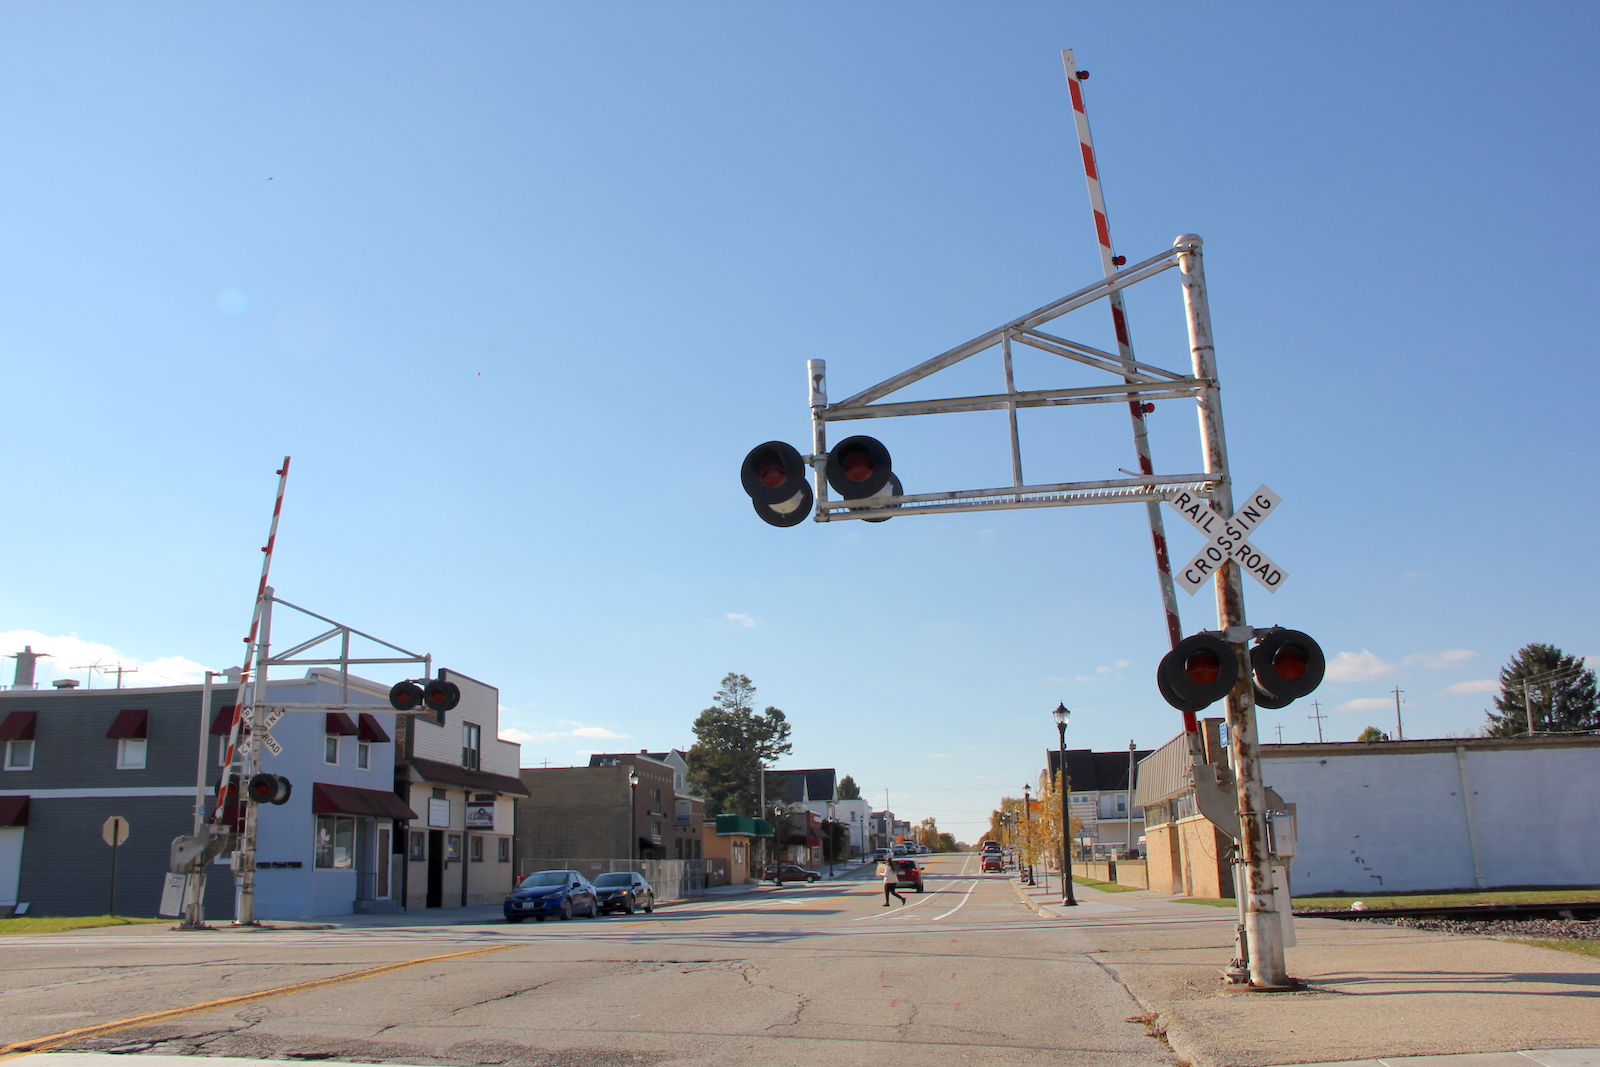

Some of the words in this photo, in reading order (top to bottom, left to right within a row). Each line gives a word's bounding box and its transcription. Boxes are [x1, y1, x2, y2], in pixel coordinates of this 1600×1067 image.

[1174, 492, 1215, 534] RAIL
[1235, 544, 1281, 586] ROAD
[1185, 495, 1271, 585] CROSSING
[263, 733, 280, 753] ROAD
